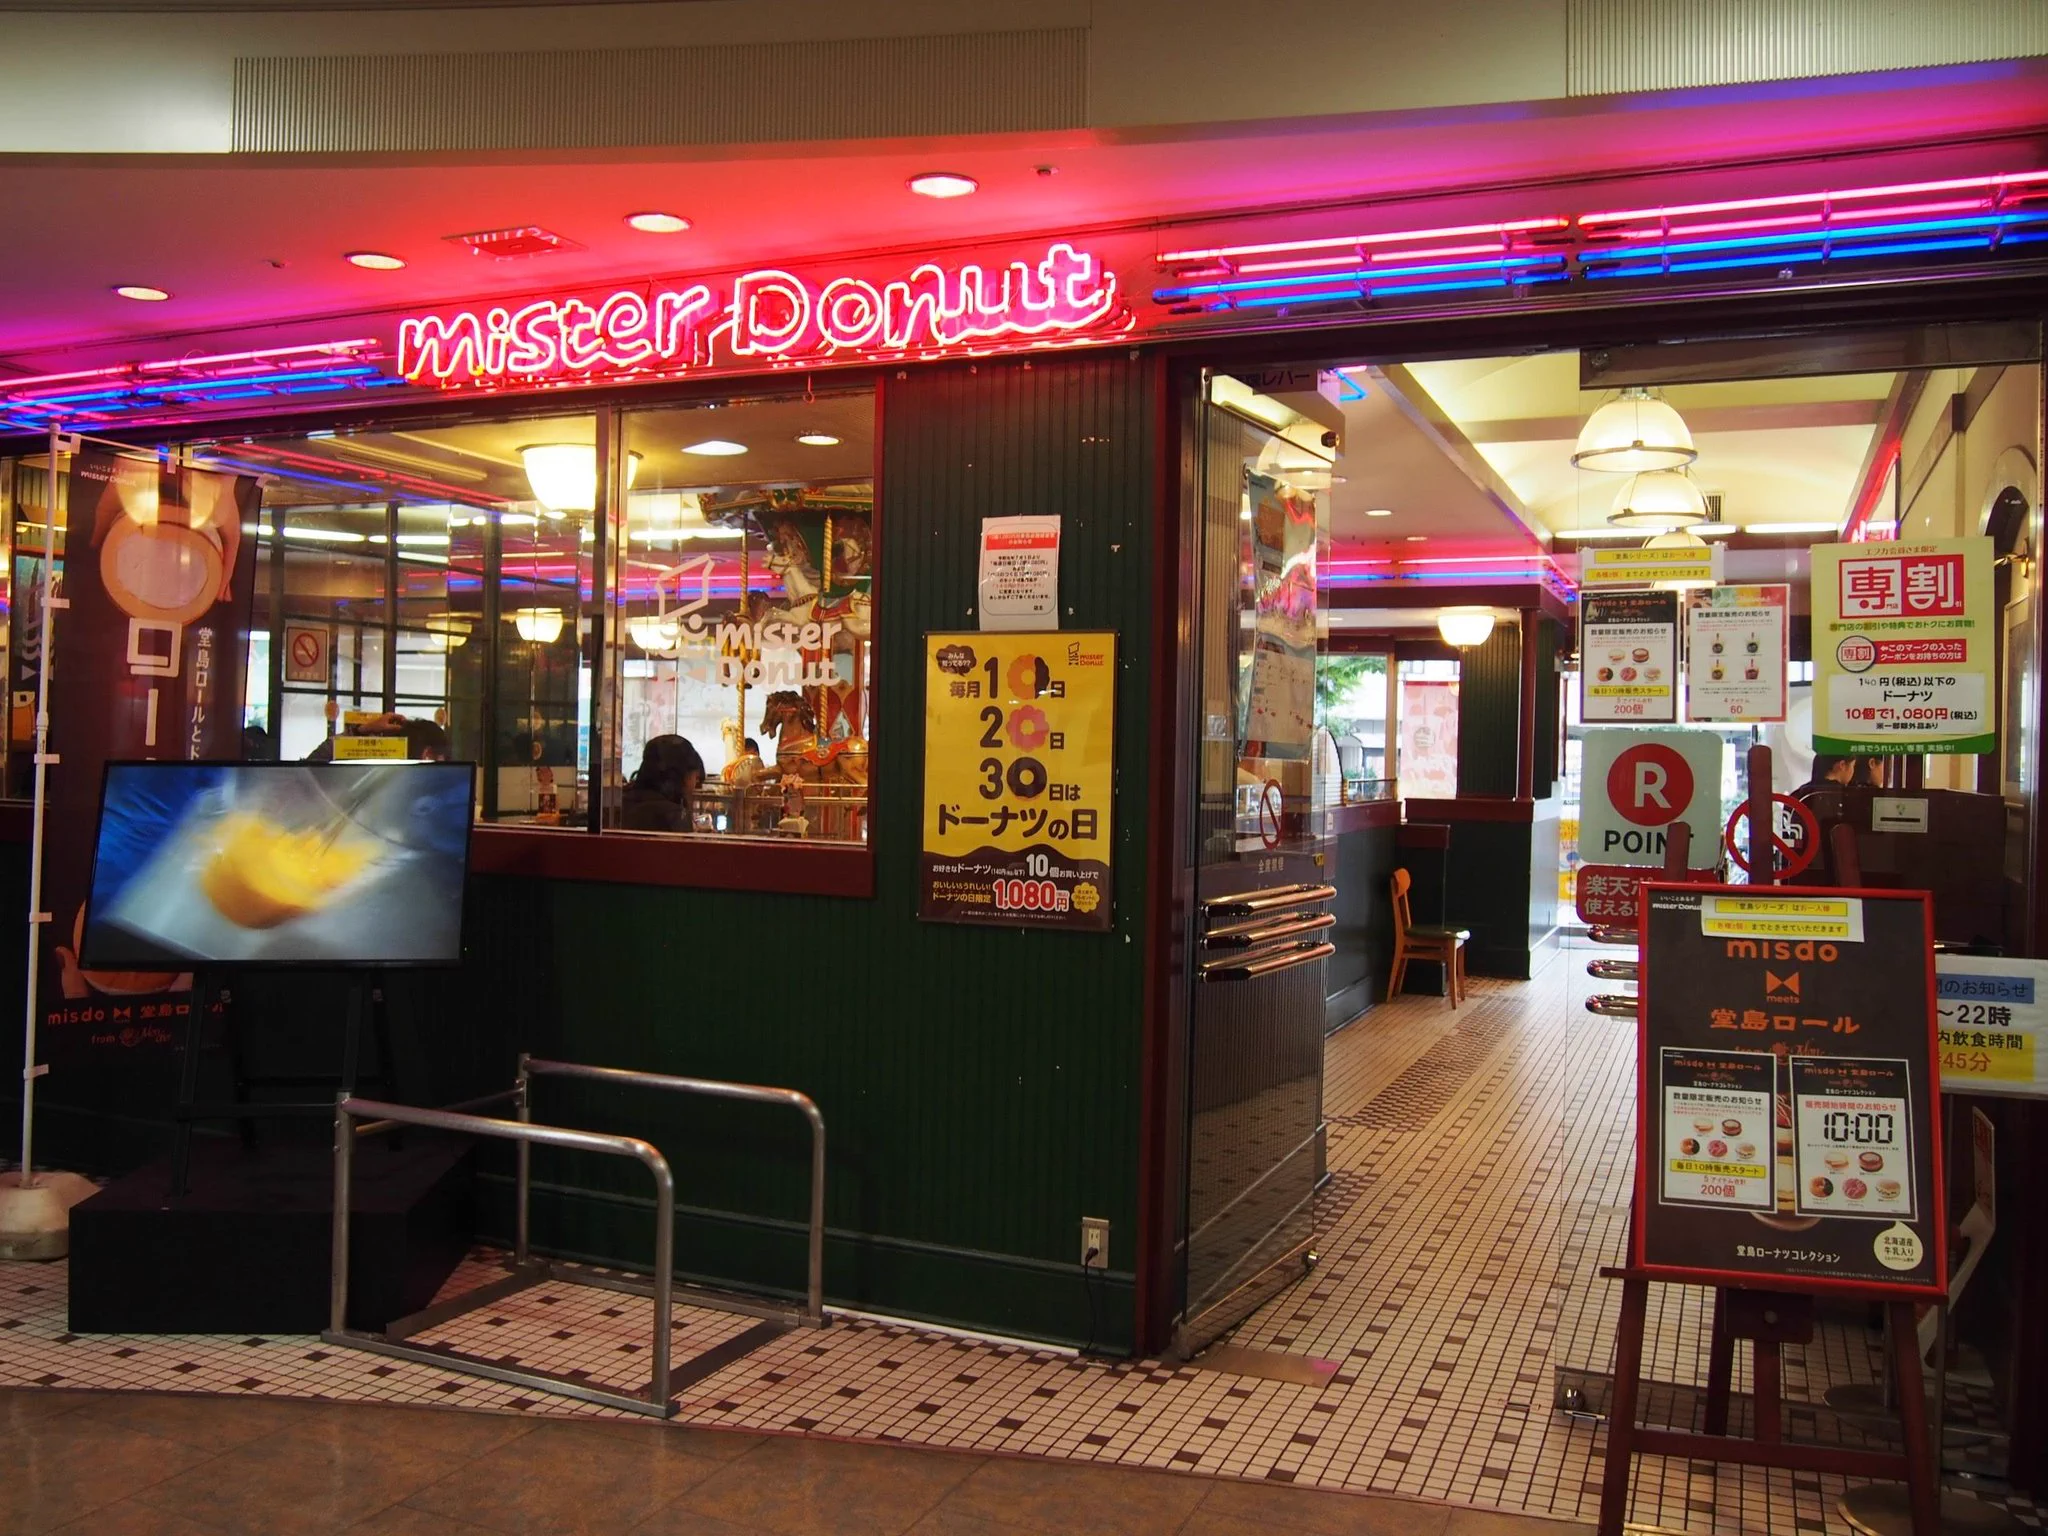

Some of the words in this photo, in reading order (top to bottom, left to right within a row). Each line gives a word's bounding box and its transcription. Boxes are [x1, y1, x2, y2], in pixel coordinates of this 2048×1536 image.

[399, 281, 711, 379] mister
[730, 243, 1117, 358] Donut
[715, 621, 842, 650] mister
[1880, 652, 1963, 661] クーポンをお持ちの方は
[1888, 643, 1963, 653] このマークの入った
[714, 657, 843, 688] Donut
[1883, 690, 1933, 703] ドーナツ
[1614, 703, 1644, 715] 200個
[1730, 705, 1743, 714] 60
[1633, 761, 1672, 809] R
[938, 804, 1098, 840] ドーナツの日
[1604, 829, 1695, 855] POIN
[932, 892, 992, 904] ドーナツの日限定
[992, 879, 1070, 912] 1,080円
[1726, 939, 1839, 963] misdo
[1766, 995, 1801, 1004] meets
[48, 1007, 105, 1025] misdo
[1709, 1008, 1861, 1035] 堂島ロール
[1938, 1051, 1992, 1073] 45分
[1672, 1092, 1763, 1106] 数量限定販売のお知らせ
[1823, 1112, 1894, 1144] 10:00
[1676, 1161, 1760, 1175] 毎日10時販売スタート
[1700, 1184, 1736, 1198] 200個
[1883, 1235, 1914, 1247] 北海道産
[1736, 1244, 1842, 1264] 堂島ローナツコレクション
[1884, 1246, 1914, 1257] 牛乳入り
